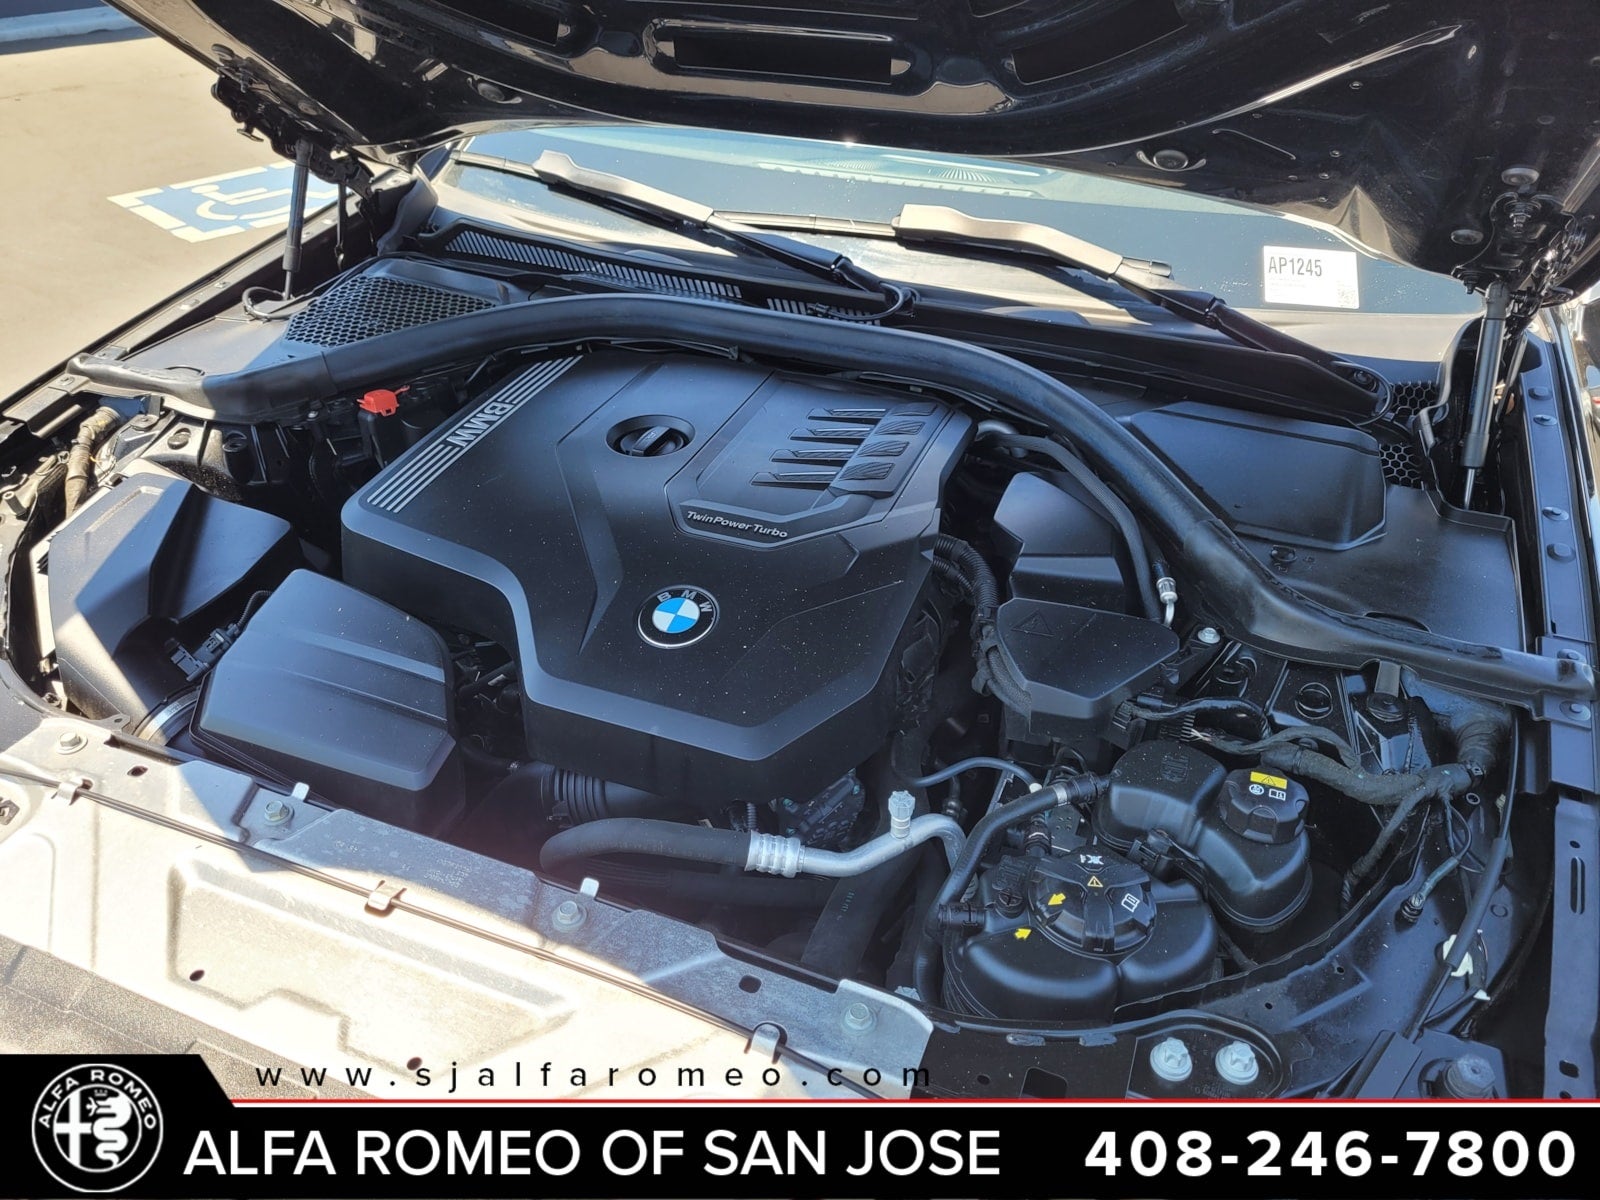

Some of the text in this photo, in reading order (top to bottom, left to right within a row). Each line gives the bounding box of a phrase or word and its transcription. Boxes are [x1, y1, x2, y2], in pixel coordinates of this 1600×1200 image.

[1268, 256, 1323, 277] AP1245
[446, 401, 516, 448] BMW
[656, 589, 713, 612] BMW
